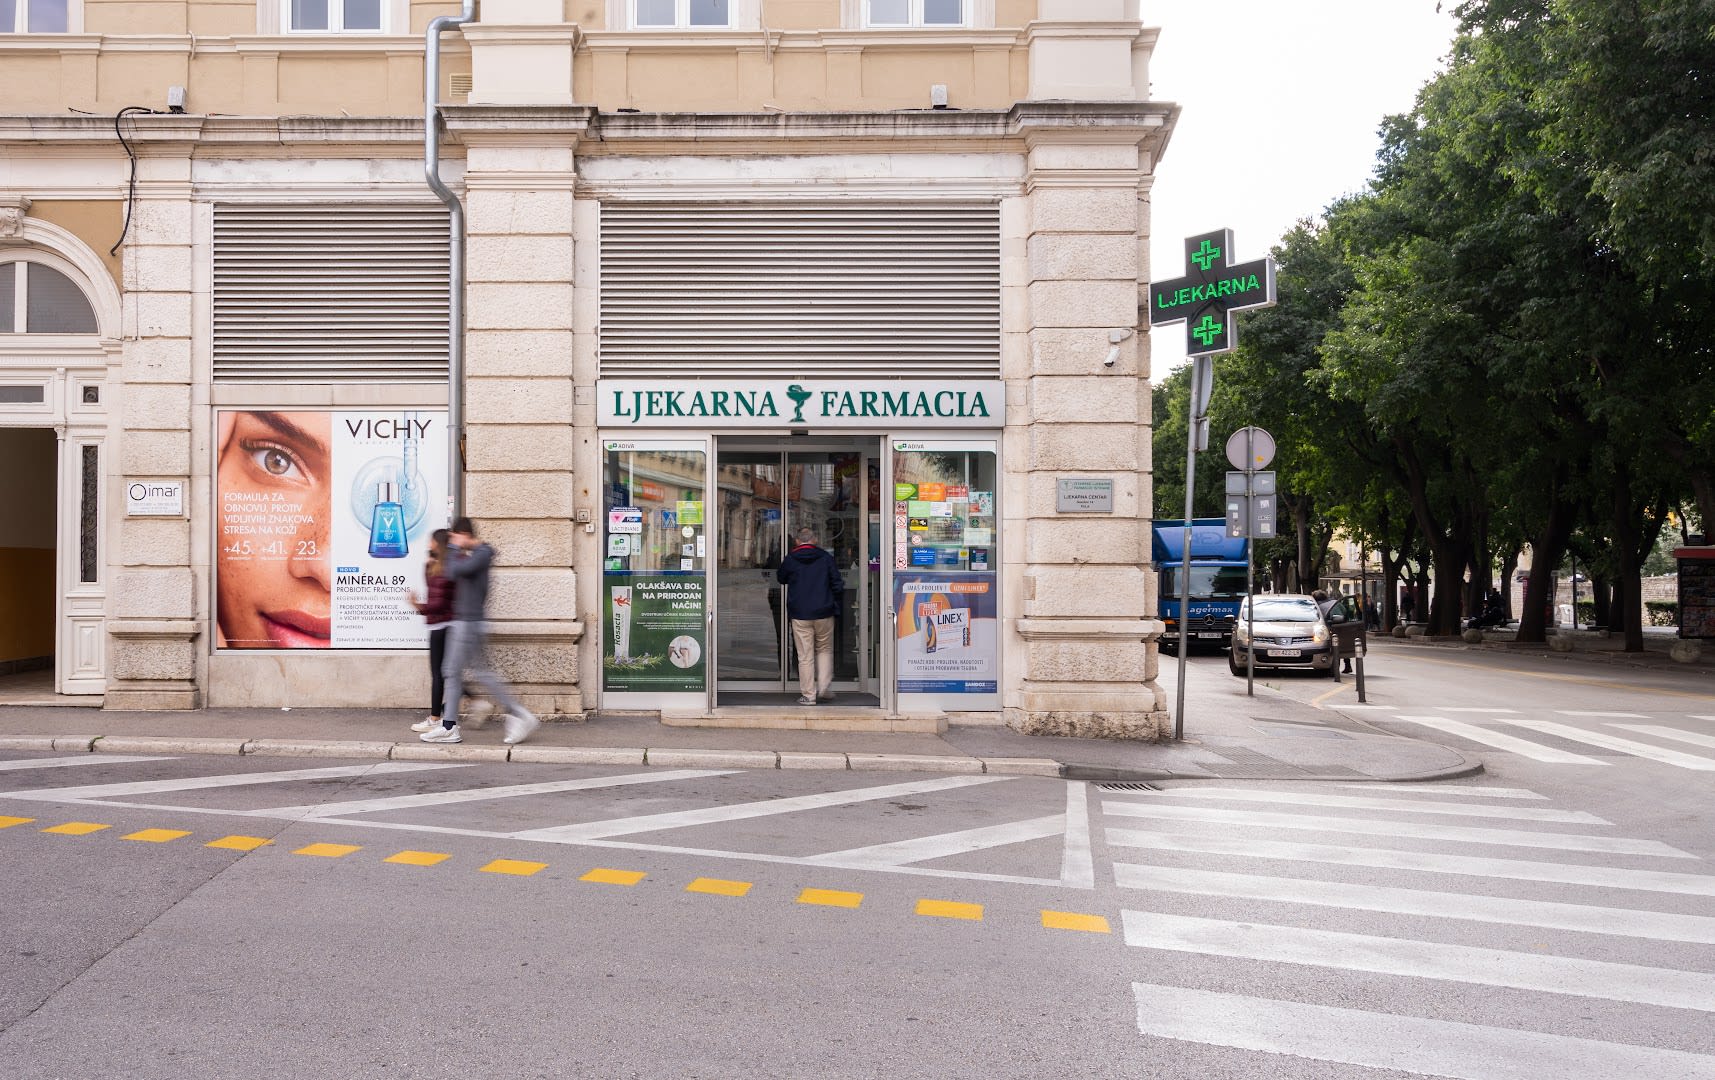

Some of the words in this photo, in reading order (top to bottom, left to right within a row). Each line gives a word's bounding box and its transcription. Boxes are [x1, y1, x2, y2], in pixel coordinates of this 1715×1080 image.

[1158, 274, 1260, 309] LJEKARNA
[613, 390, 780, 423] LJEKARNA
[820, 390, 991, 418] FARMACIA
[345, 419, 432, 439] VICHY
[224, 492, 270, 502] FORMULA
[271, 492, 285, 502] ZA
[224, 503, 269, 513] OBNOVU,
[271, 503, 303, 513] PROTIV
[224, 514, 266, 524] VIDLJIVIH
[268, 514, 314, 524] ZNAKOVA
[224, 525, 256, 535] STRESA
[258, 525, 273, 535] NA
[275, 524, 297, 535] KOŽI
[336, 573, 389, 585] MINÉRAL
[391, 575, 406, 585] 89
[636, 581, 681, 590] OLAKŠAVA
[684, 582, 702, 590] BOL
[642, 592, 655, 600] NA
[657, 592, 702, 600] PRIRODAN
[671, 601, 702, 609] NAČIN!
[1188, 607, 1234, 615] agermax
[937, 613, 962, 625] LINEX
